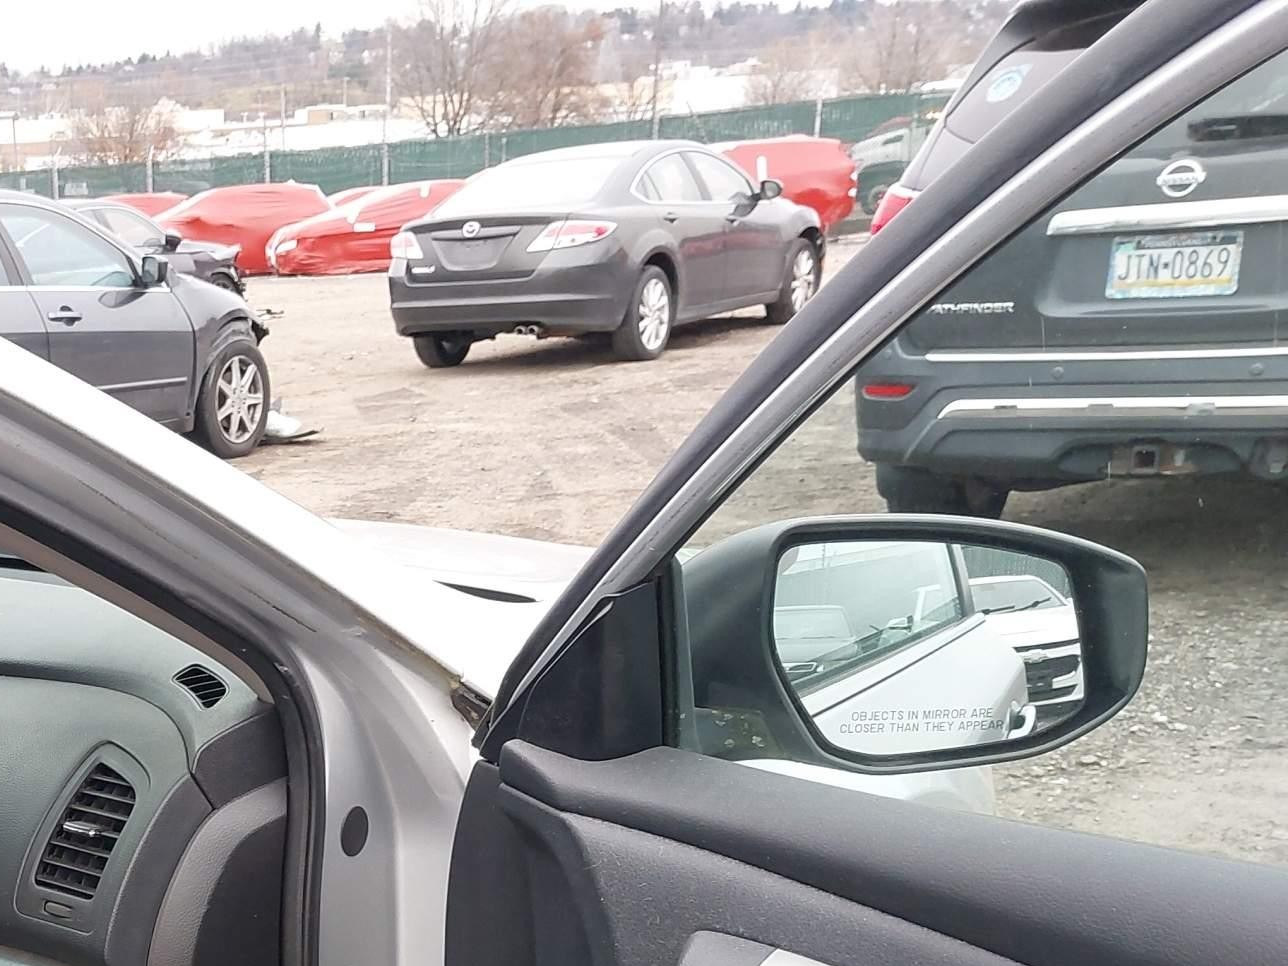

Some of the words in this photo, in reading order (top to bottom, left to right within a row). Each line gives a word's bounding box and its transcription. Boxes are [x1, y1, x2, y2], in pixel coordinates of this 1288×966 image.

[851, 710, 904, 721] OBJECTS
[907, 710, 919, 720] IN
[922, 708, 966, 720] MIRROR
[970, 707, 993, 718] ARE
[839, 723, 885, 734] CLOSER
[890, 722, 919, 732] THAN
[925, 721, 954, 731] THEY
[958, 719, 1005, 730] APPEAR
